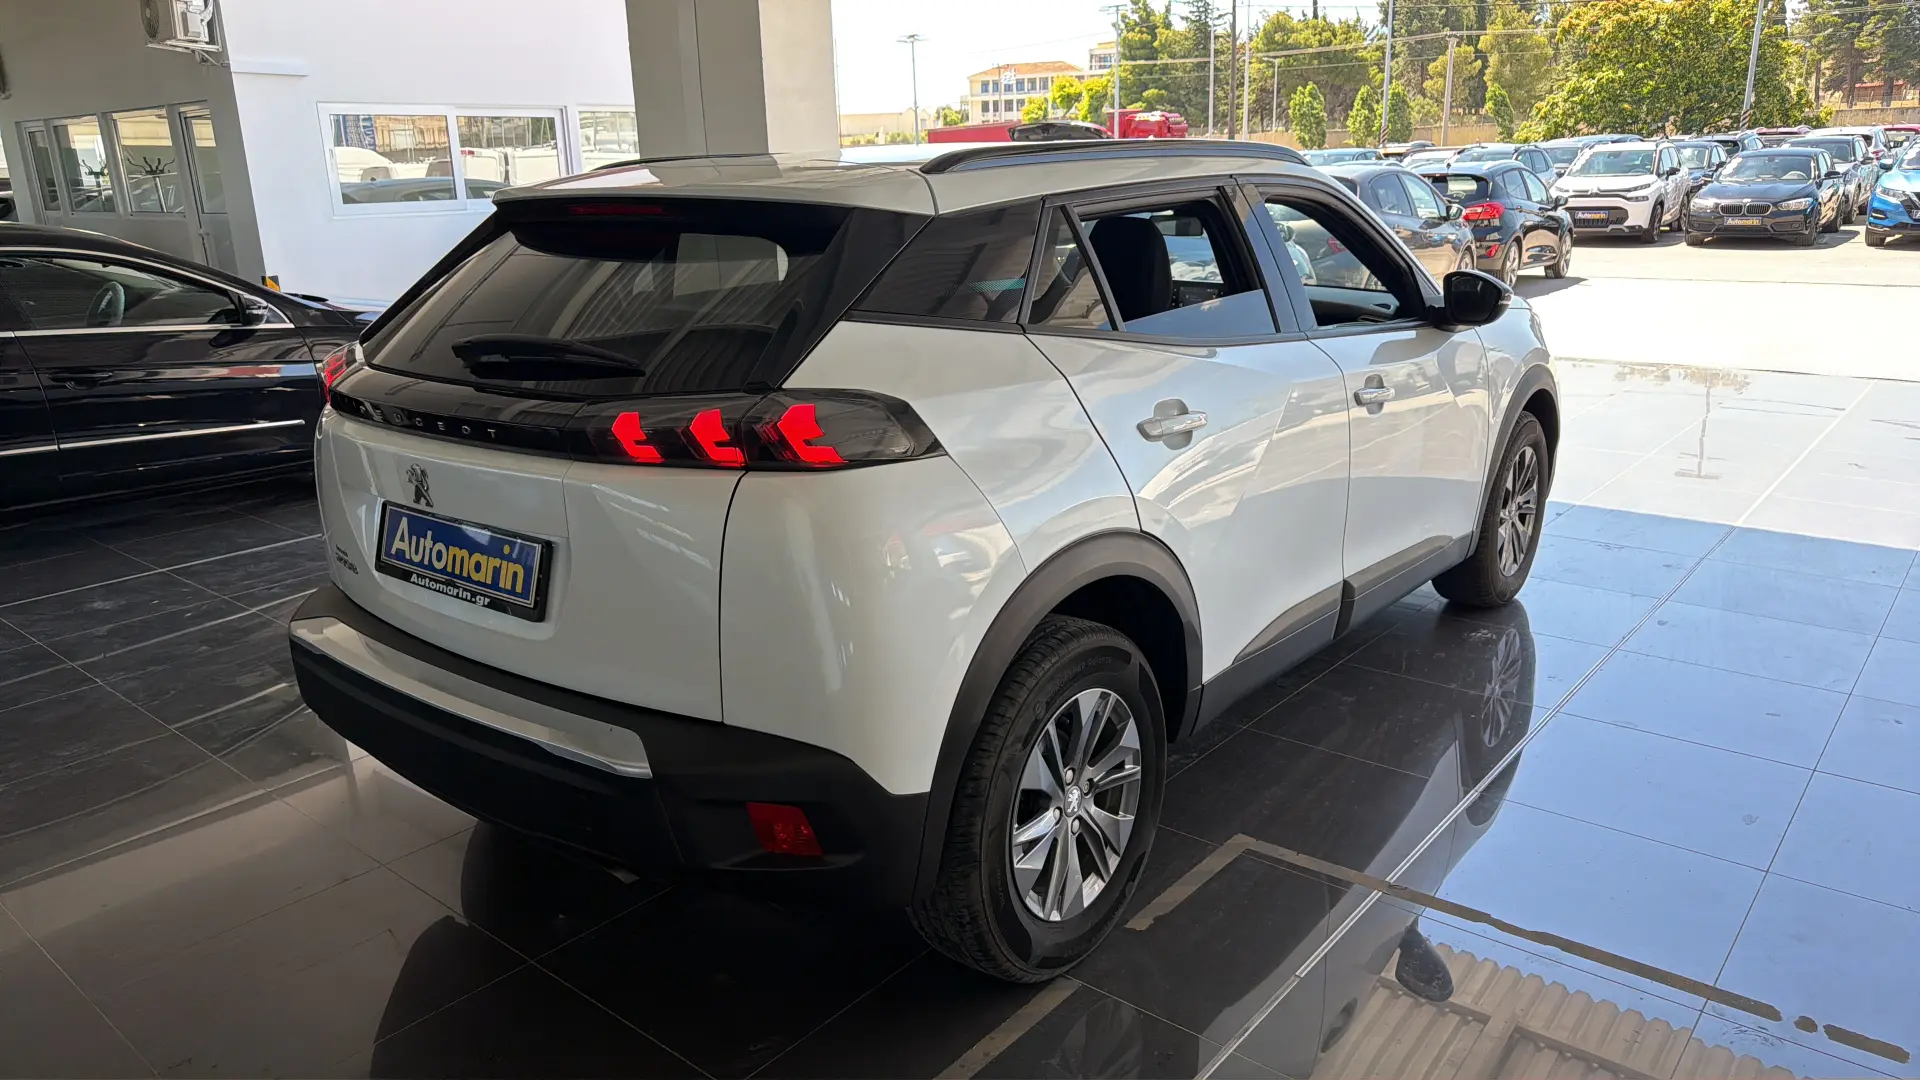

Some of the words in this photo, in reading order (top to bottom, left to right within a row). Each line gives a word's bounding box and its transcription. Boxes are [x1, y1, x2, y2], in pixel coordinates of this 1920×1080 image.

[1727, 217, 1760, 225] Automarin
[391, 517, 524, 594] Automarin
[410, 573, 491, 607] Automarin.gr
